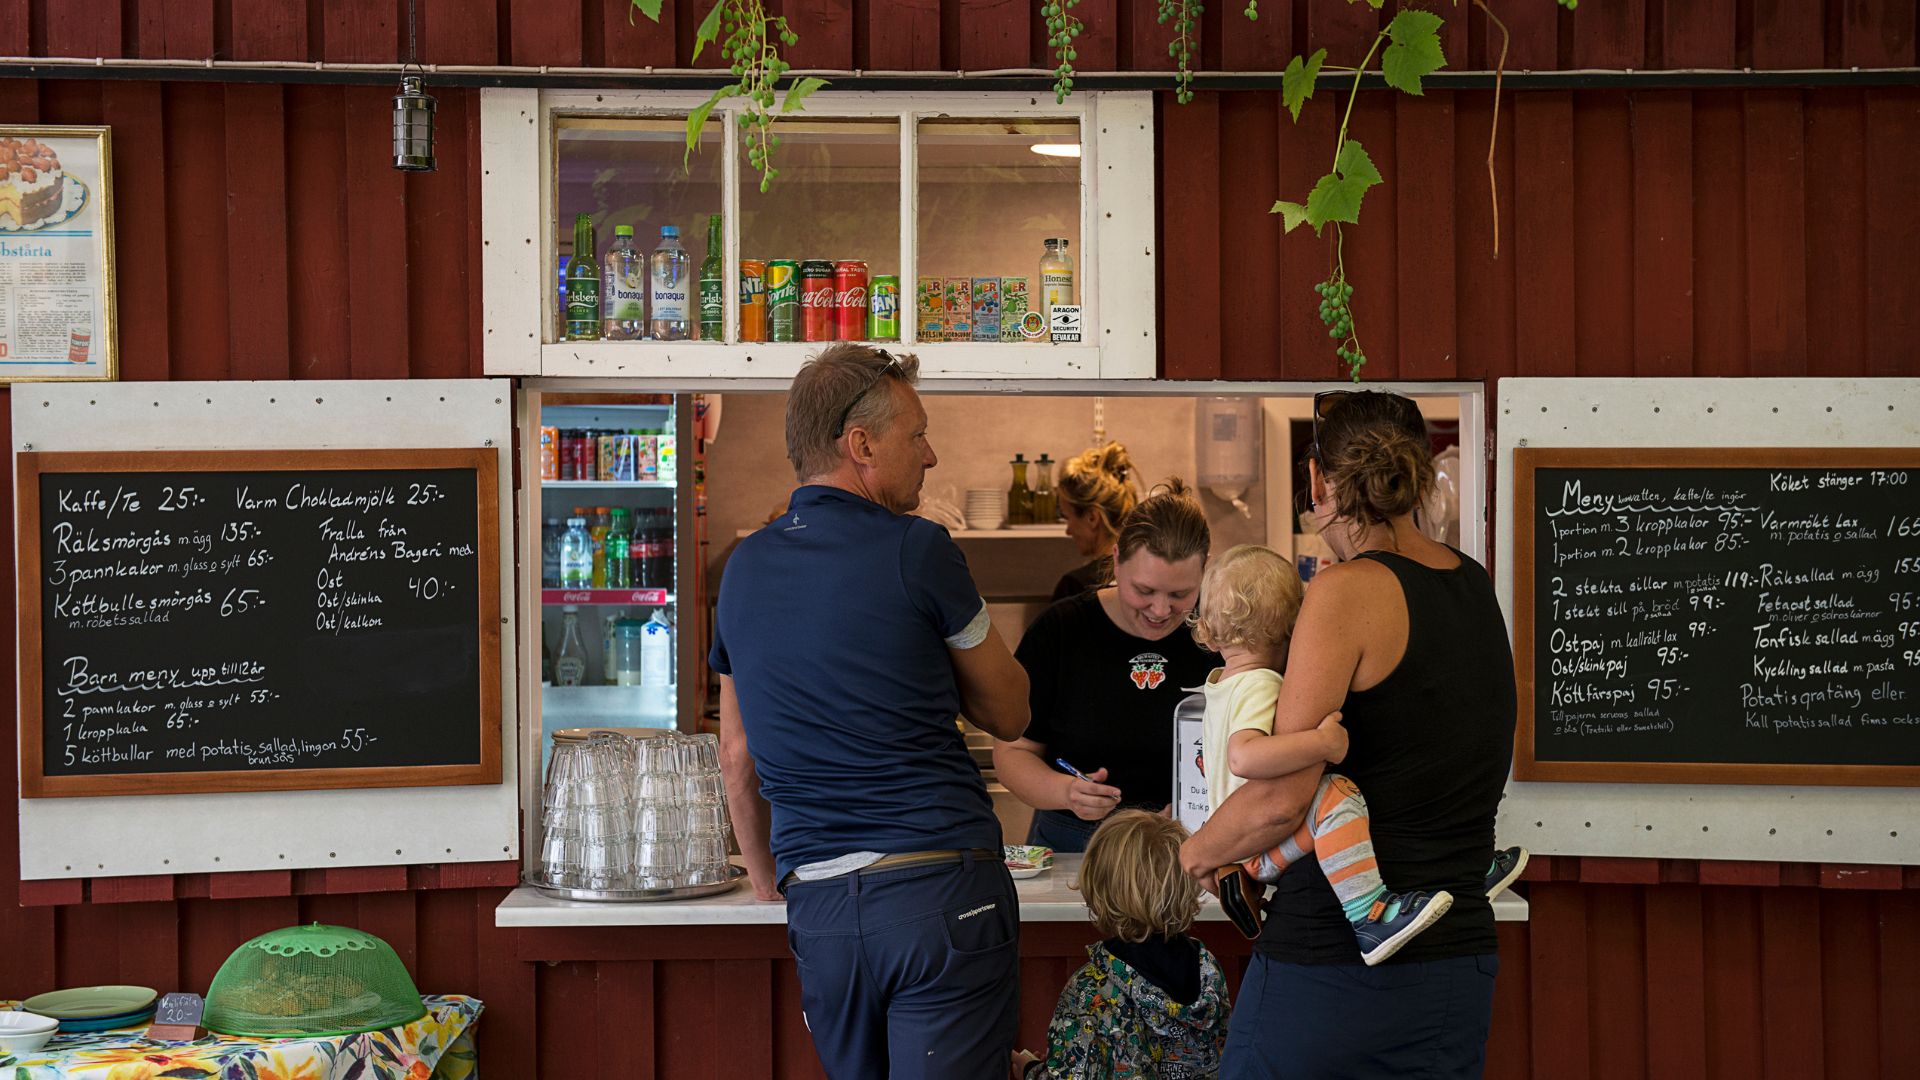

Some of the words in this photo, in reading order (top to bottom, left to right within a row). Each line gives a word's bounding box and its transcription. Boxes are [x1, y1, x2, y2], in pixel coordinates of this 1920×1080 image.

[566, 290, 599, 306] rlsberg
[655, 291, 685, 301] bonaqua
[740, 277, 764, 294] NTA
[766, 287, 796, 305] Sprite
[835, 287, 866, 307] a-Cola
[1770, 472, 1809, 492] Köket
[1818, 472, 1863, 491] stänger
[1871, 471, 1907, 486] 17:00
[59, 486, 141, 519] Kaffe/Te
[158, 487, 206, 512] 25:-
[236, 486, 277, 510] Varm
[286, 483, 395, 513] Chokladmjölk
[407, 483, 445, 505] 25:-
[1563, 479, 1614, 515] Meny
[1722, 490, 1747, 504] ingår
[319, 517, 365, 542] Fralla
[379, 519, 407, 538] från
[1615, 516, 1630, 532] 3
[1636, 515, 1709, 536] kroppkakor
[1718, 512, 1752, 530] 95:-
[1761, 510, 1830, 530] Varmrökt
[53, 522, 171, 555] Räksmörgås
[221, 522, 262, 541] 135:-
[1616, 537, 1631, 556] 2
[1636, 538, 1708, 559] kroppkakor
[1715, 533, 1749, 551] 85:-
[1787, 530, 1829, 546] potatis
[1844, 528, 1877, 539] sallad
[221, 554, 240, 575] sylt
[248, 550, 274, 567] 65:-
[328, 545, 386, 563] Andréns
[391, 541, 441, 563] Bageri
[317, 568, 343, 590] Ost
[409, 577, 455, 600] 40:-
[1552, 577, 1567, 597] 2
[1575, 577, 1623, 596] stekta
[1629, 576, 1668, 592] sillar
[1685, 572, 1720, 594] potatis
[1724, 571, 1759, 589] 119:-
[1760, 563, 1835, 588] Räksallad
[220, 588, 266, 617] 65:-
[317, 591, 382, 614] Ost/skinka
[1553, 599, 1559, 621] 1
[1564, 604, 1600, 620] stekt
[1607, 603, 1627, 617] sill
[1632, 601, 1645, 622] på
[1652, 598, 1680, 612] bröd
[1689, 594, 1725, 611] 99:-
[316, 610, 382, 636] Ost/kalkon
[1626, 630, 1660, 648] kallrökt
[1664, 629, 1678, 643] lax
[1688, 622, 1717, 637] 99:-
[191, 665, 215, 681] upp
[1552, 655, 1628, 680] Ost/skinkpaj
[1657, 647, 1689, 666] 95:-
[1866, 658, 1895, 679] pasta
[1647, 678, 1690, 700] 95:-
[63, 700, 76, 718] 2
[180, 698, 203, 715] glass
[219, 695, 240, 710] sylt
[250, 690, 279, 704] 55:-
[64, 726, 71, 741] 1
[78, 724, 149, 743] kroppkaka
[166, 713, 199, 729] 65:-
[1746, 711, 1768, 728] Kall
[1861, 713, 1887, 725] finns
[64, 745, 77, 765] 5
[82, 744, 154, 764] köttbullar
[166, 742, 195, 758] med
[341, 728, 377, 752] 55:-
[1188, 802, 1203, 810] Tänk
